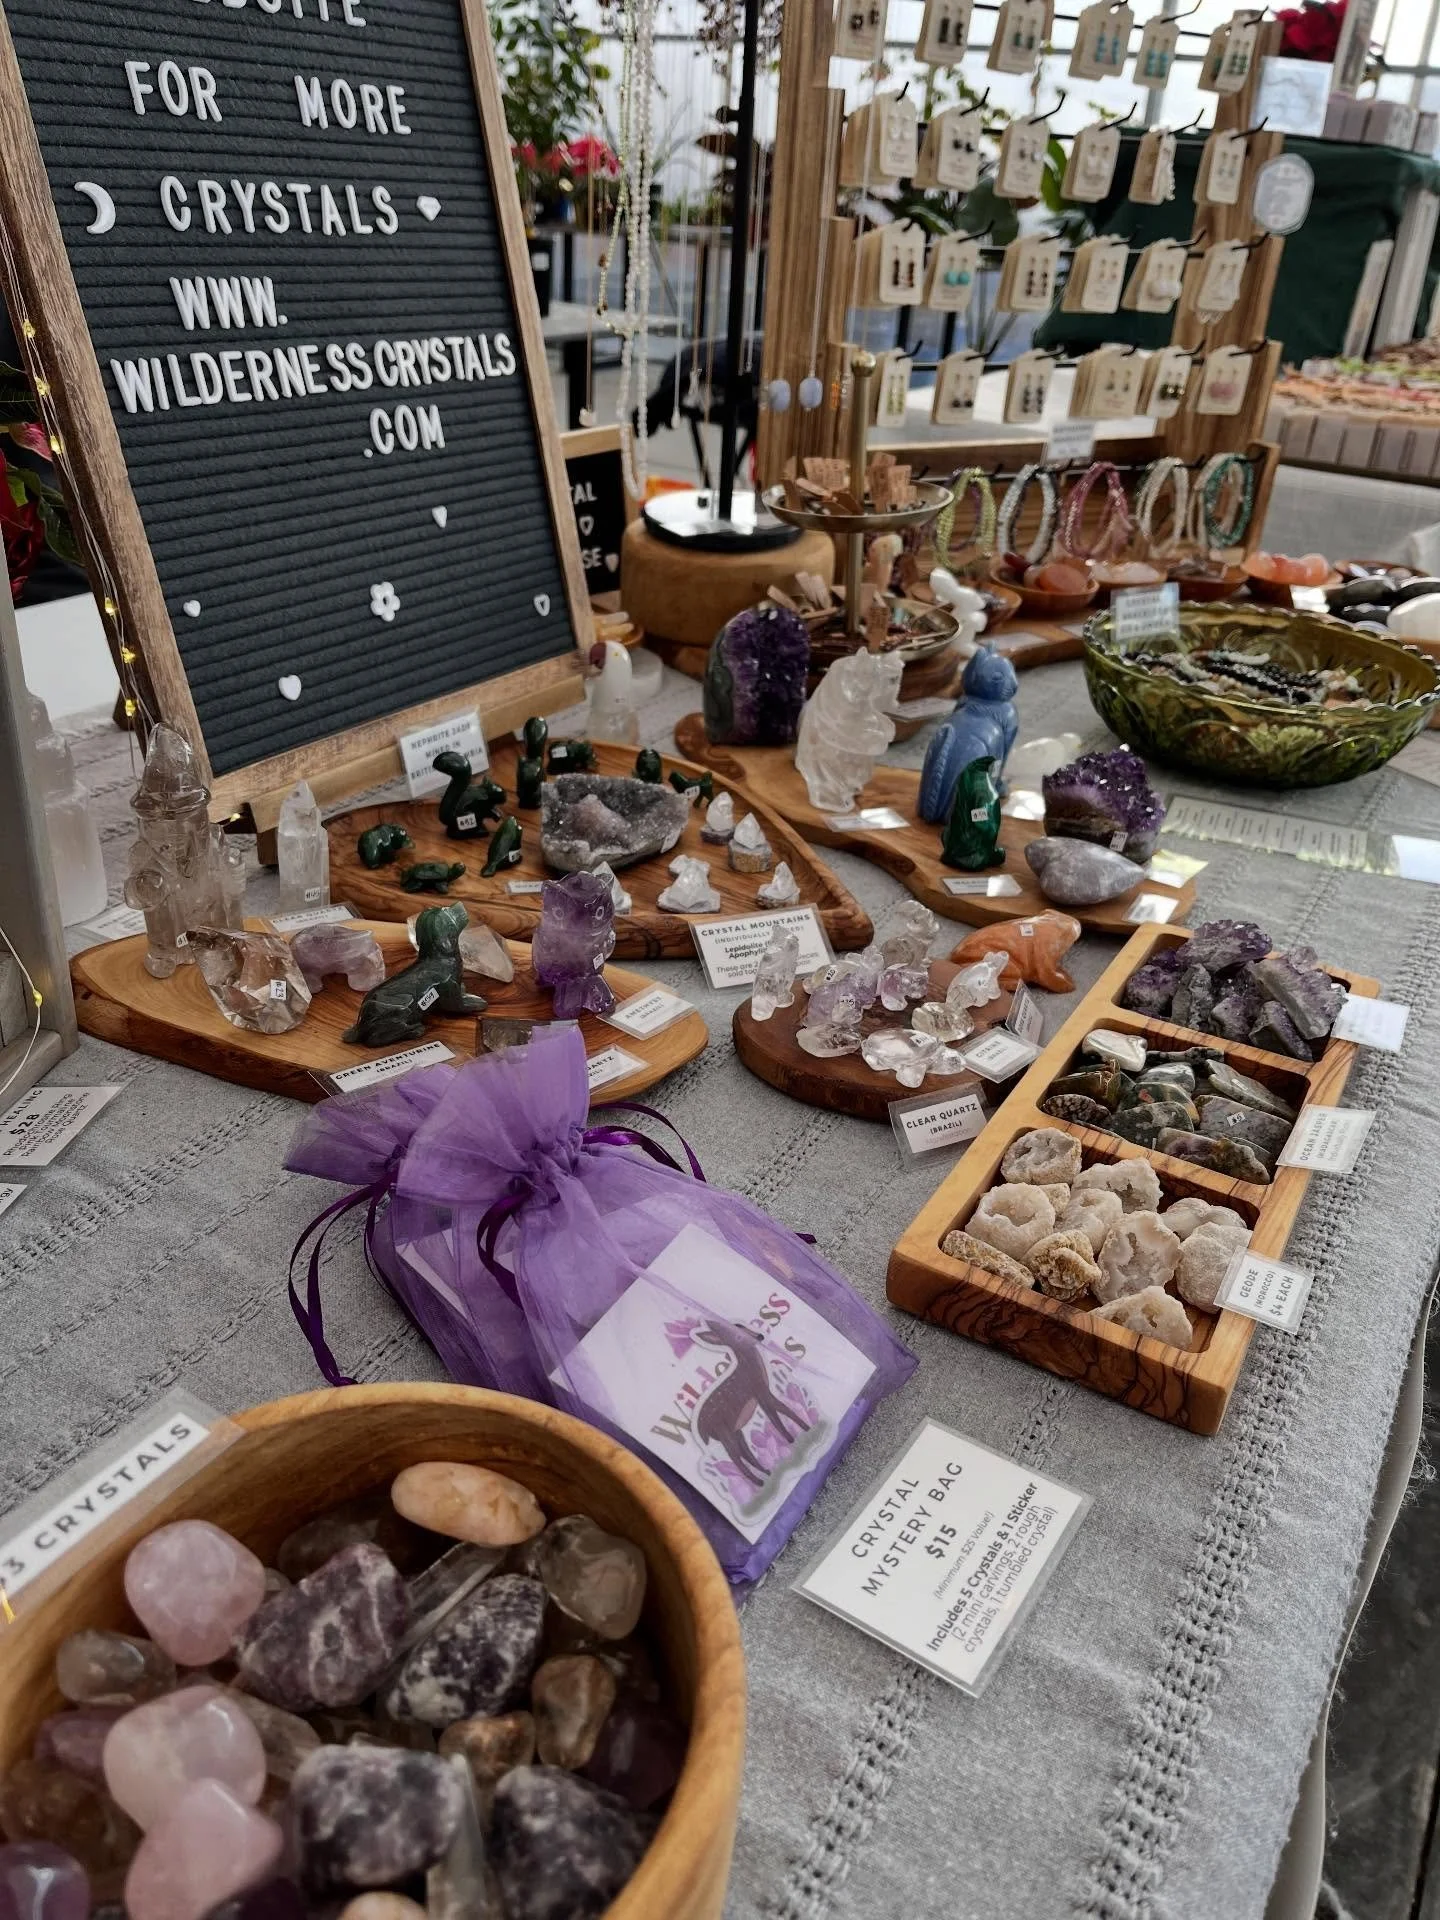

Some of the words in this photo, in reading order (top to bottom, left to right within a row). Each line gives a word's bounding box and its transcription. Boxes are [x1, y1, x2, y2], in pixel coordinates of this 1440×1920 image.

[125, 60, 223, 122] FOR
[294, 75, 412, 136] MORE
[160, 175, 399, 236] CRYSTALS
[169, 275, 288, 331] WWW.
[363, 403, 446, 458] .COM
[700, 924, 748, 938] CRYSTAL
[749, 913, 812, 930] MOUNTAINS
[724, 942, 763, 954] Lepidolite
[335, 1064, 372, 1080] GREEN
[374, 1042, 441, 1067] AVENTURINE
[375, 1058, 414, 1073] (BRAZIL)
[9, 1113, 41, 1136] $28
[906, 1113, 938, 1130] CLEAR
[939, 1102, 979, 1121] QUARTZ
[930, 1120, 963, 1135] (BRAZIL)
[1239, 1268, 1259, 1298] GEODE
[1254, 1270, 1277, 1309] (MOROCCO)
[1275, 1275, 1295, 1302] EACH
[1268, 1304, 1284, 1317] $4
[33, 1423, 192, 1551] CRYSTALS
[1007, 1482, 1038, 1524] Sticker
[851, 1479, 920, 1559] CRYSTAL
[861, 1504, 932, 1597] MYSTERY
[927, 1462, 963, 1502] BAG
[996, 1530, 1010, 1541] &
[924, 1524, 957, 1560] $15
[933, 1555, 967, 1600] (Minimum
[961, 1538, 976, 1557] $25
[951, 1626, 968, 1642] (2
[961, 1599, 985, 1629] mini
[979, 1547, 1017, 1600] carvings,
[1007, 1537, 1021, 1549] 2
[1015, 1504, 1042, 1540] rough
[964, 1604, 1001, 1654] crystals,
[996, 1547, 1033, 1598] tumbled
[1027, 1504, 1059, 1548] crystal)
[967, 1540, 1003, 1588] Crystals
[961, 1587, 974, 1599] 5
[926, 1597, 968, 1652] Includes
